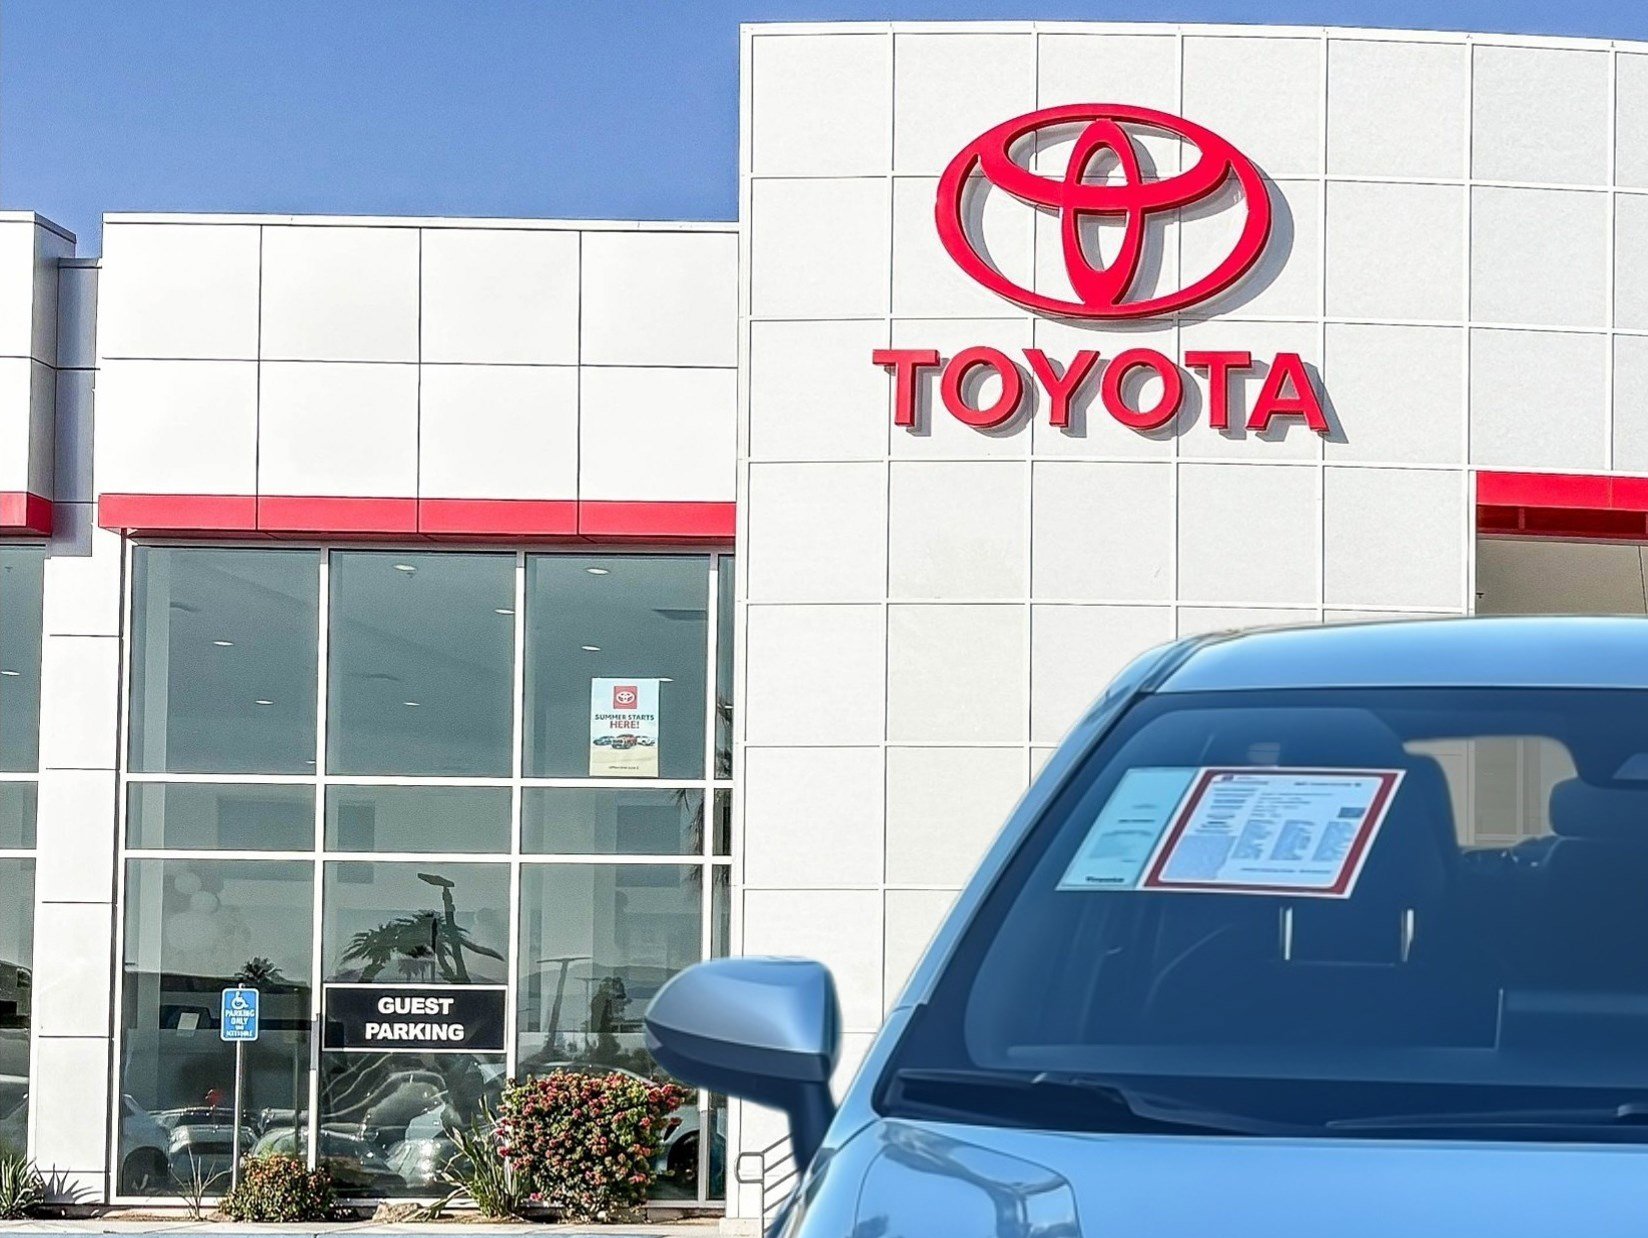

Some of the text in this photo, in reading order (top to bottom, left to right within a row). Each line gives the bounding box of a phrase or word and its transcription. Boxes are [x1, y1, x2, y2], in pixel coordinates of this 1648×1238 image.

[872, 346, 1328, 431] TOYOTA
[609, 721, 640, 729] HERE!
[377, 997, 454, 1015] GUEST
[225, 1009, 255, 1018] PARKING
[230, 1016, 249, 1025] ONLY
[365, 1022, 465, 1041] PARKING
